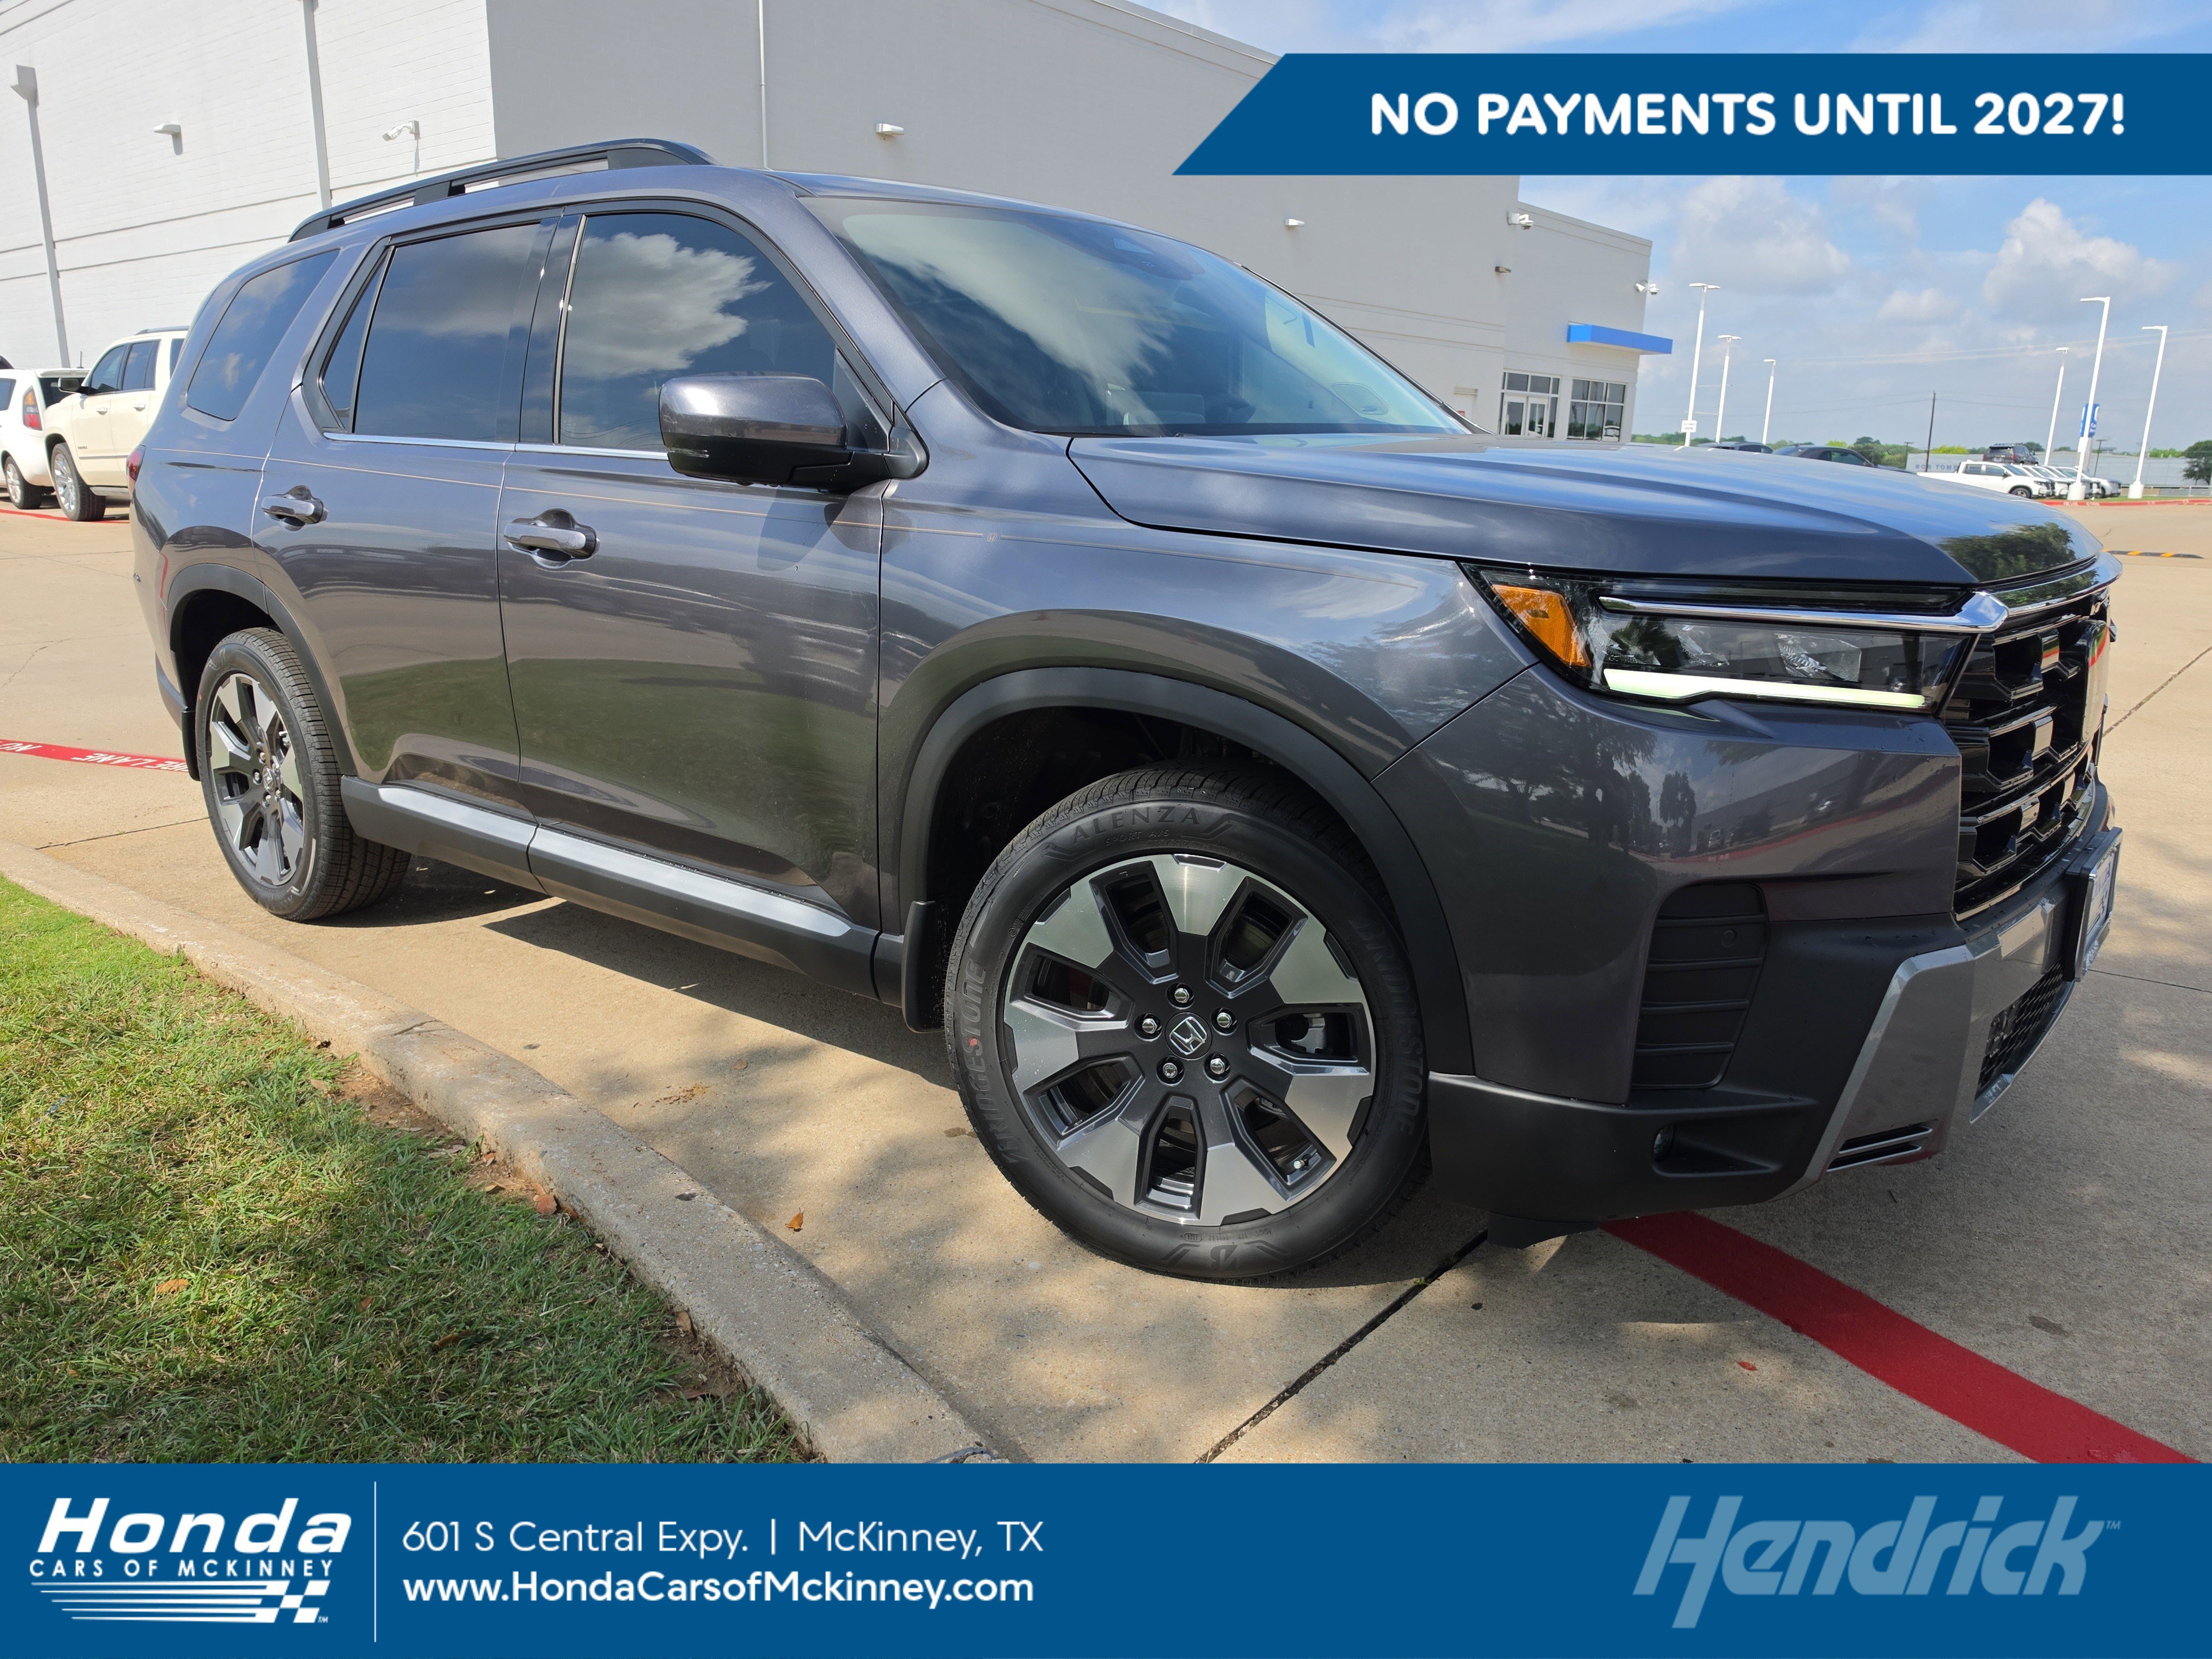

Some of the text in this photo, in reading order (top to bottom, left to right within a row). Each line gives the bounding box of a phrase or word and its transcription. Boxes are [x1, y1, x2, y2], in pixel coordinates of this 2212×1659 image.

[71, 753, 158, 767] LANE
[1072, 806, 1201, 845] ALENZA
[1105, 829, 1170, 846] SPORT A/S
[1349, 916, 1424, 1136] BRIDGESTONE
[960, 958, 1029, 1165] BRIDGESTONE
